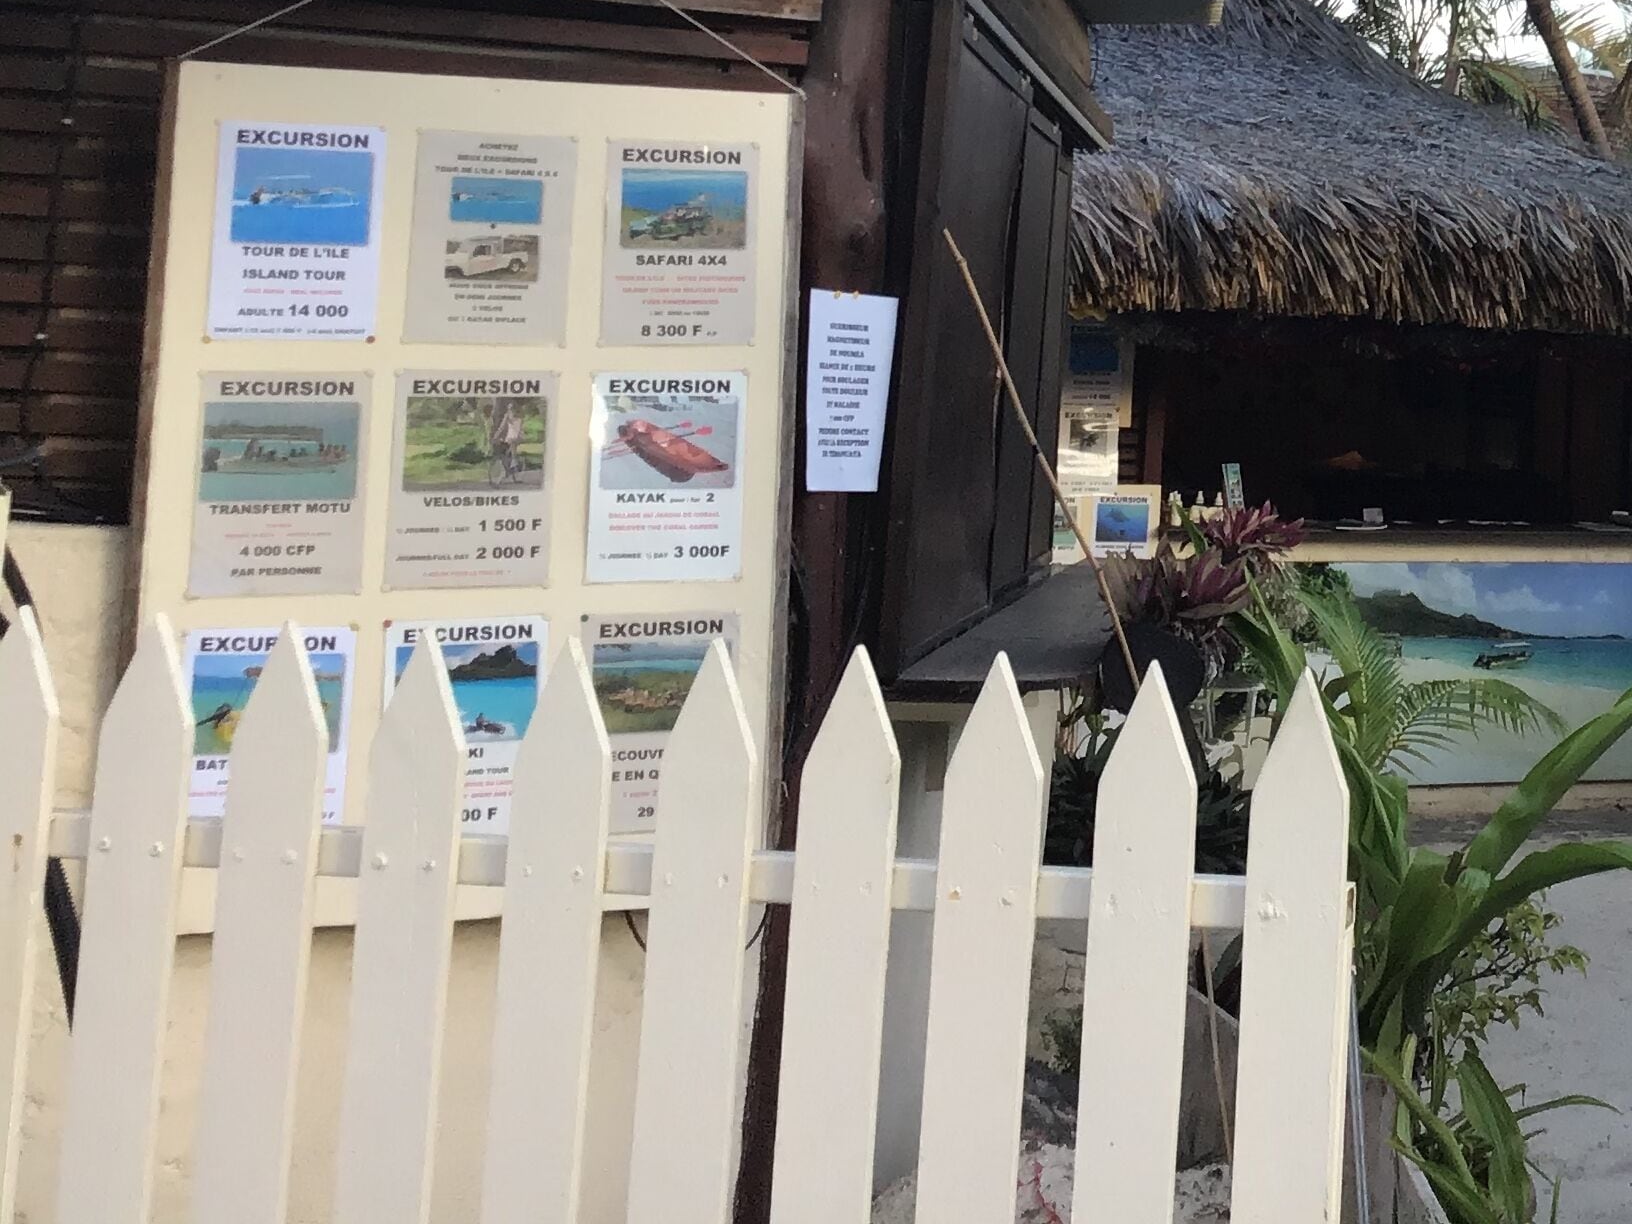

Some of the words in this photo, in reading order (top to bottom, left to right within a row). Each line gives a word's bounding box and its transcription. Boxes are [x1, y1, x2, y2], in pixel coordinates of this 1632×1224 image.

[236, 129, 370, 149] EXCURSION
[622, 148, 741, 165] EXCURSION
[242, 246, 284, 257] TOUR
[289, 247, 309, 258] DE
[636, 255, 693, 266] SAFARI
[698, 255, 727, 266] 4X4
[242, 269, 299, 280] ISLAND
[304, 270, 346, 281] TOUR
[289, 305, 309, 317] 14
[316, 305, 349, 317] 000
[641, 325, 652, 337] 8
[657, 325, 687, 337] 300
[692, 325, 702, 337] F
[220, 381, 355, 397] EXCURSION
[413, 380, 540, 394] EXCURSION
[609, 380, 731, 394] EXCURSION
[616, 493, 665, 503] KAYAK
[706, 493, 715, 503] 2
[1100, 496, 1148, 505] EXCURSION
[209, 504, 301, 515] TRANSFERT
[305, 503, 351, 514] MOTU
[479, 520, 487, 531] 1
[494, 519, 525, 531] 500
[532, 518, 542, 531] F
[254, 545, 282, 556] 000
[286, 545, 315, 555] CFP
[476, 547, 487, 559] 2
[492, 546, 524, 559] 000
[530, 546, 540, 557] F
[674, 546, 683, 558] 3
[404, 624, 533, 643] ECURSION
[600, 619, 724, 638] EXCURSION
[624, 770, 644, 781] EN
[487, 807, 498, 820] F
